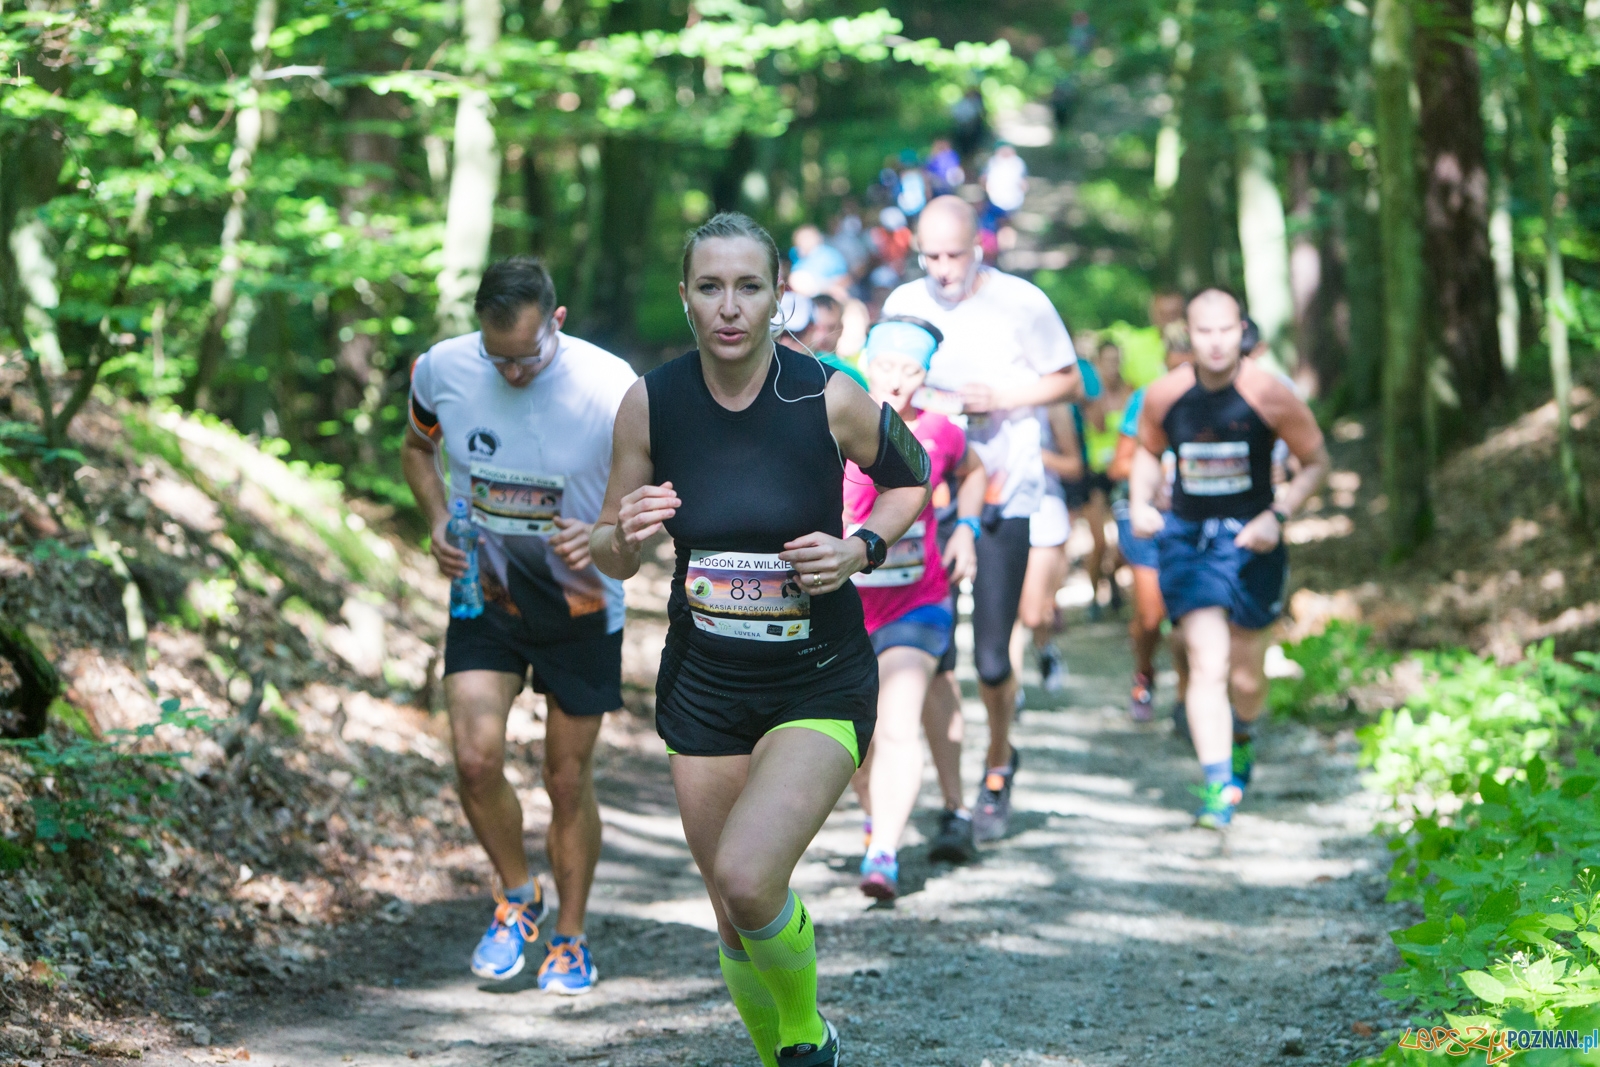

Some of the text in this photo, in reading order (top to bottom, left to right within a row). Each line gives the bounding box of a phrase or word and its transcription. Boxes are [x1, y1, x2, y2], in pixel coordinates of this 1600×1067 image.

[495, 487, 533, 506] 374
[699, 556, 792, 570] POGOŃ ZA WILKIE
[730, 577, 762, 600] 83
[709, 603, 785, 613] KASIA FRĄCKOWIAK
[734, 629, 761, 638] LUVENA
